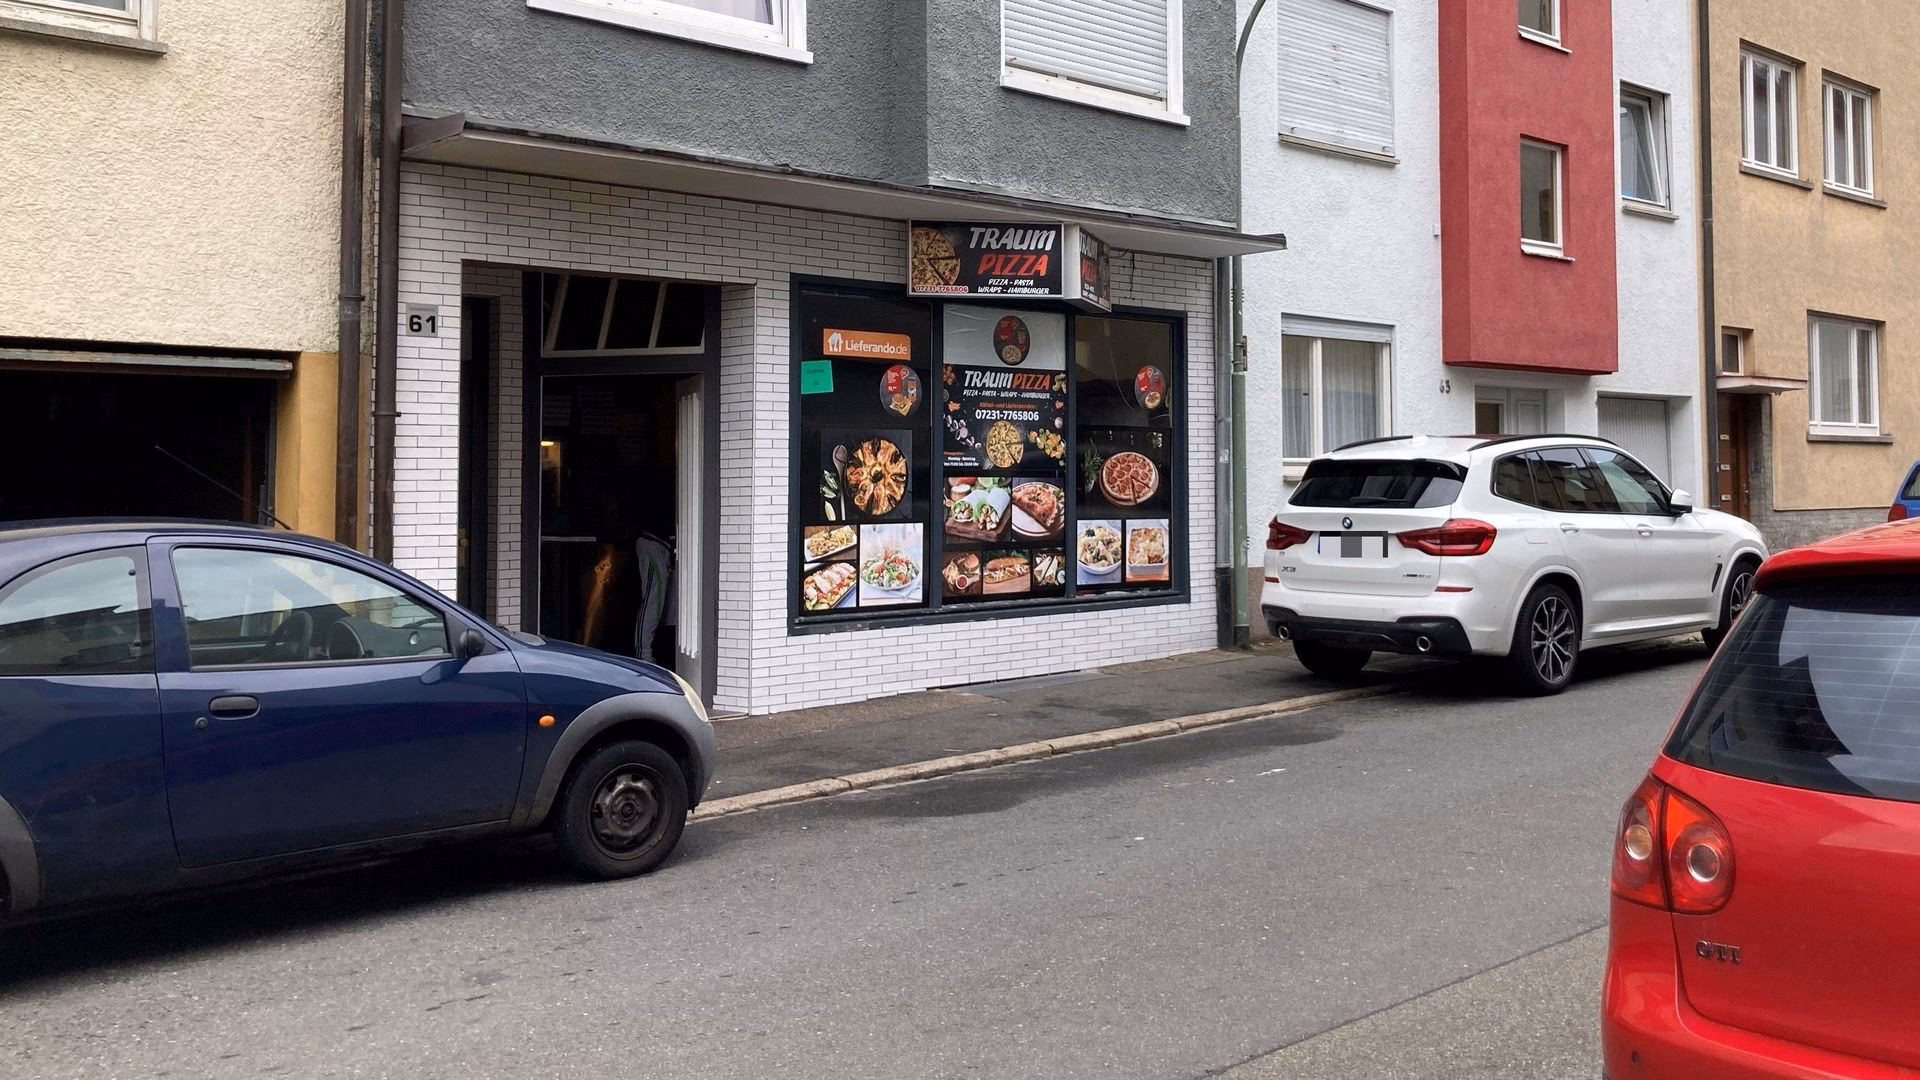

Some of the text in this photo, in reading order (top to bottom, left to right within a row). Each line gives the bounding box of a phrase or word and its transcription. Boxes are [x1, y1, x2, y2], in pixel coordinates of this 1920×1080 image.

[969, 226, 1056, 251] TRAUM
[977, 254, 1050, 277] PIZZA
[915, 285, 969, 293] 07231-7765806
[988, 278, 1008, 286] PIZZA
[1008, 286, 1050, 294] HAMBURGER
[409, 314, 436, 333] 61
[845, 340, 908, 355] Lieferando.de
[1439, 379, 1451, 394] 63
[975, 409, 1039, 421] 07231-7765806
[1695, 940, 1741, 962] GTI
